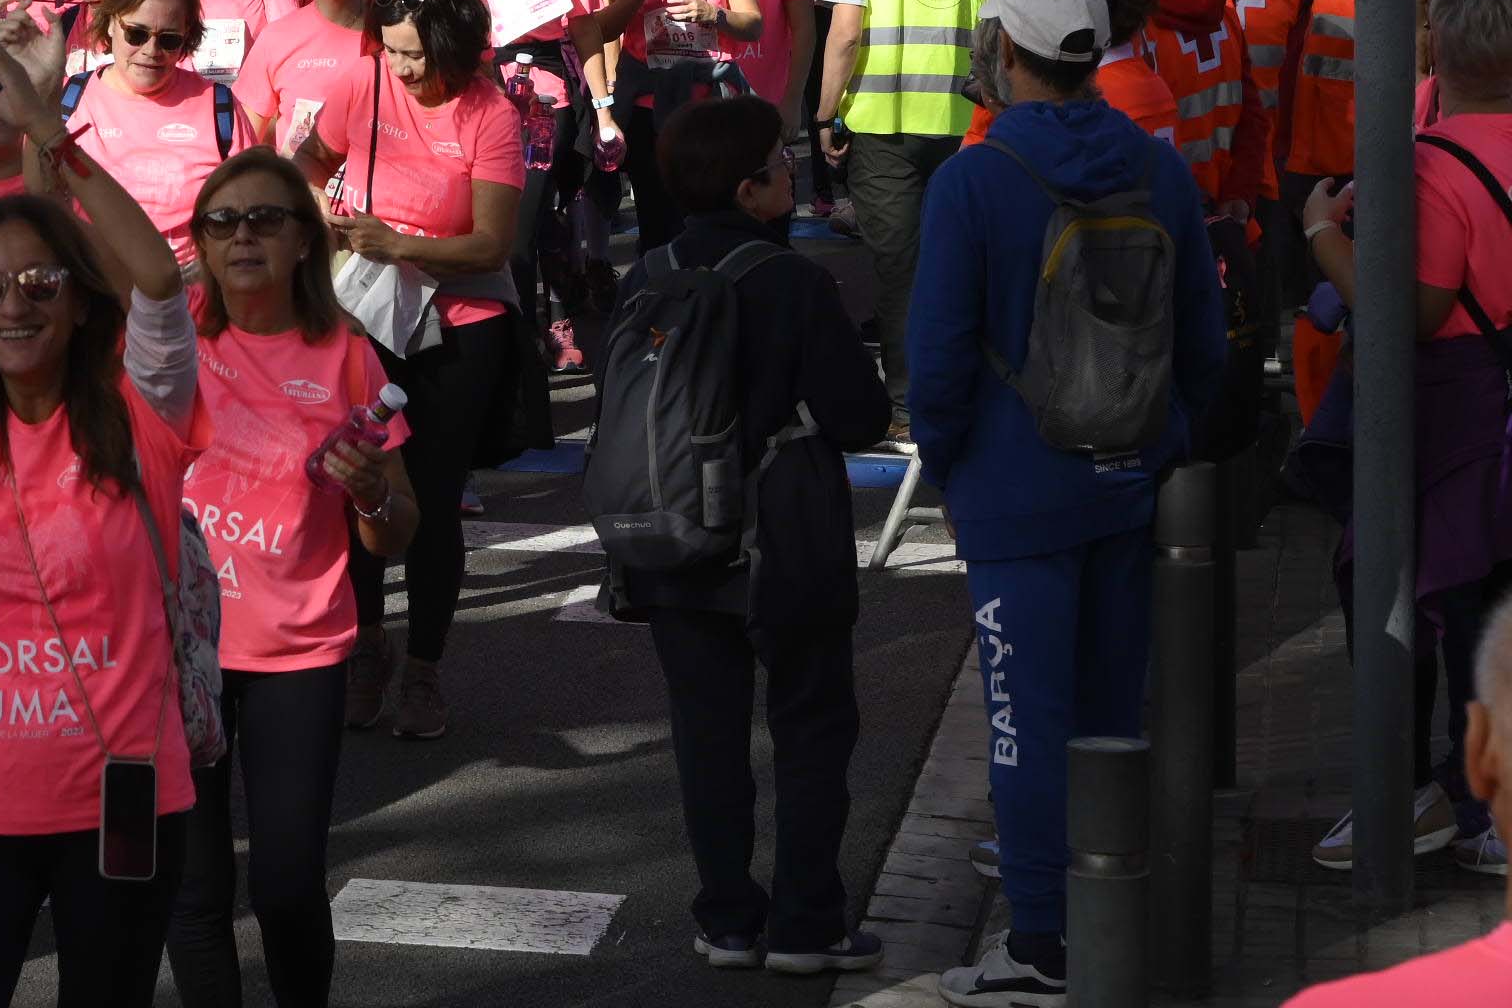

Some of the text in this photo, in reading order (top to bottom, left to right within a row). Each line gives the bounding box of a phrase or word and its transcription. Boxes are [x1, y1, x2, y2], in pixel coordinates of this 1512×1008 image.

[296, 57, 337, 70] OYSHO
[1095, 460, 1121, 474] SINCE
[182, 496, 284, 556] RSAL
[614, 522, 652, 530] Quechua
[974, 596, 1020, 768] BARÇA
